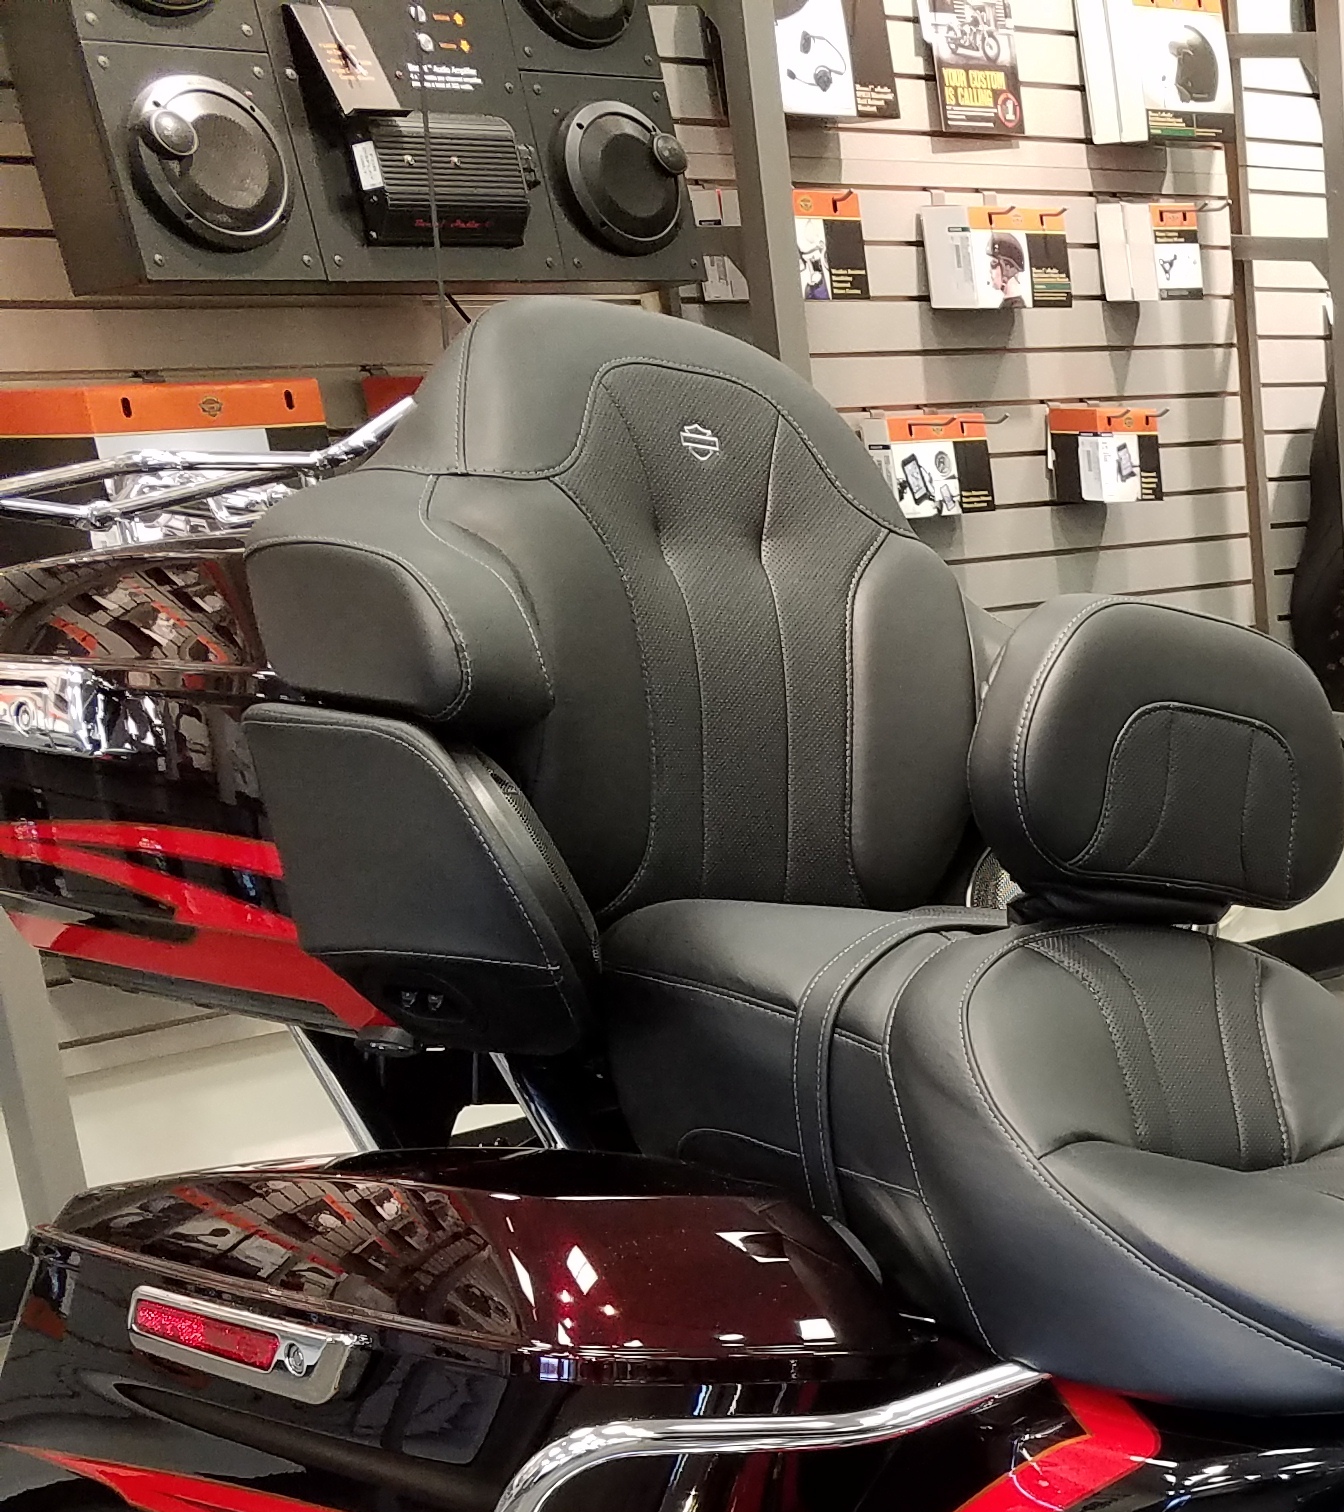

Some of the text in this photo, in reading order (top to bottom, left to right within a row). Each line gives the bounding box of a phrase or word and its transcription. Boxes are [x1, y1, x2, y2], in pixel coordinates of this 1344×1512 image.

[942, 67, 1007, 90] YOUR CUSTOM
[945, 86, 994, 107] IS CALLING
